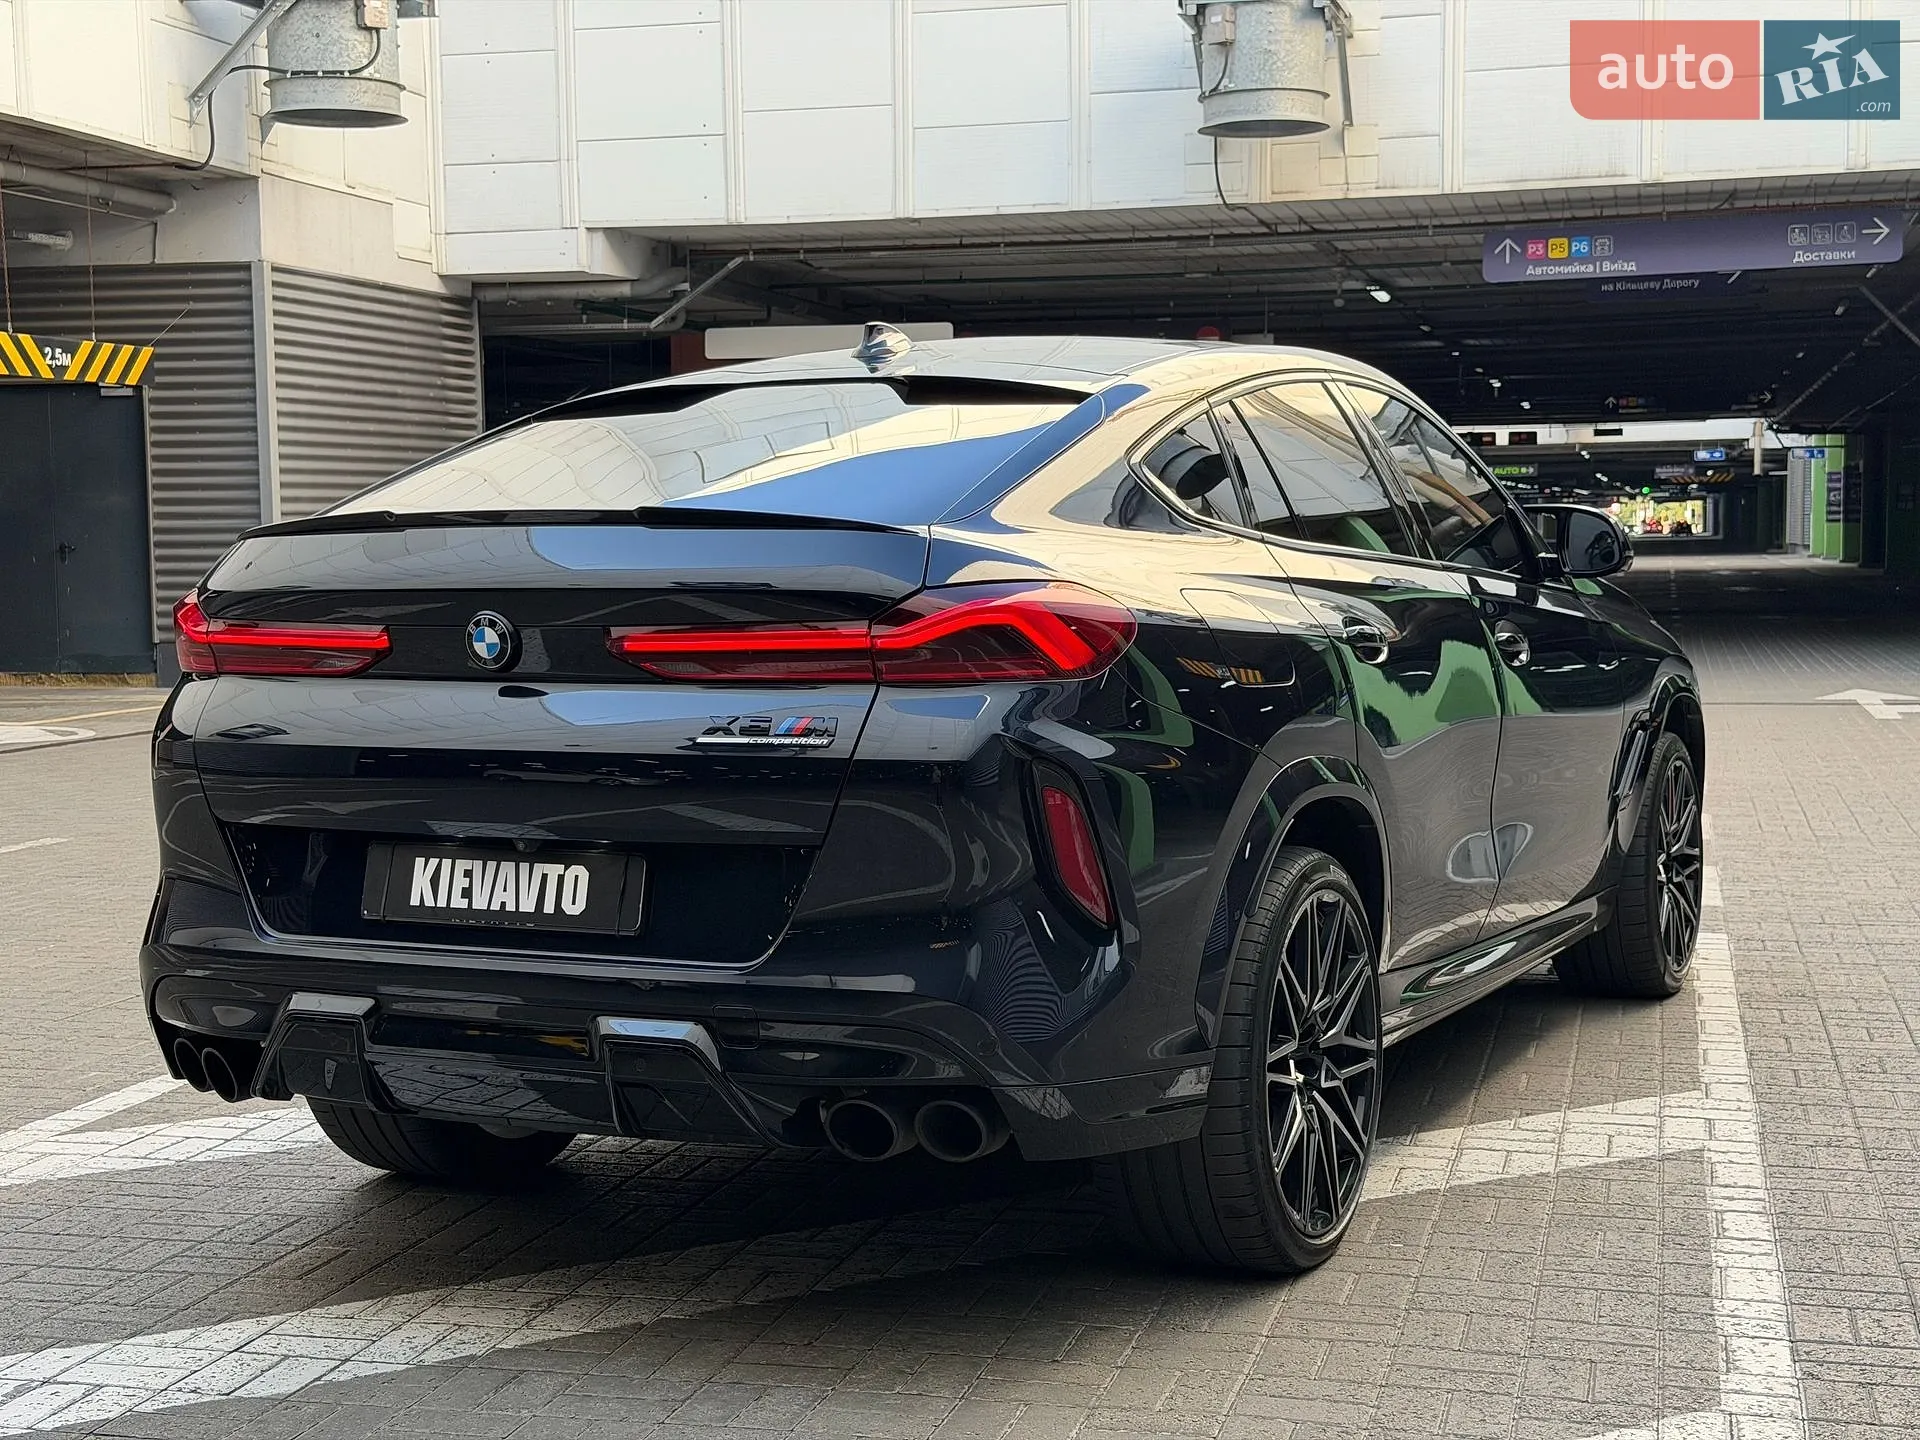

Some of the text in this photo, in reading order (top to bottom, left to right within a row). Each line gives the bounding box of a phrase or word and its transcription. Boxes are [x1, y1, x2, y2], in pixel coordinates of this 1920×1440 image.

[1528, 241, 1588, 256] P3 P5 P6
[1792, 250, 1856, 263] Доставки
[1526, 262, 1594, 276] Автомийка
[1602, 259, 1637, 272] Виїзд
[468, 617, 504, 635] BMW
[749, 737, 829, 745] competition
[410, 857, 590, 915] KIEVAVTO
